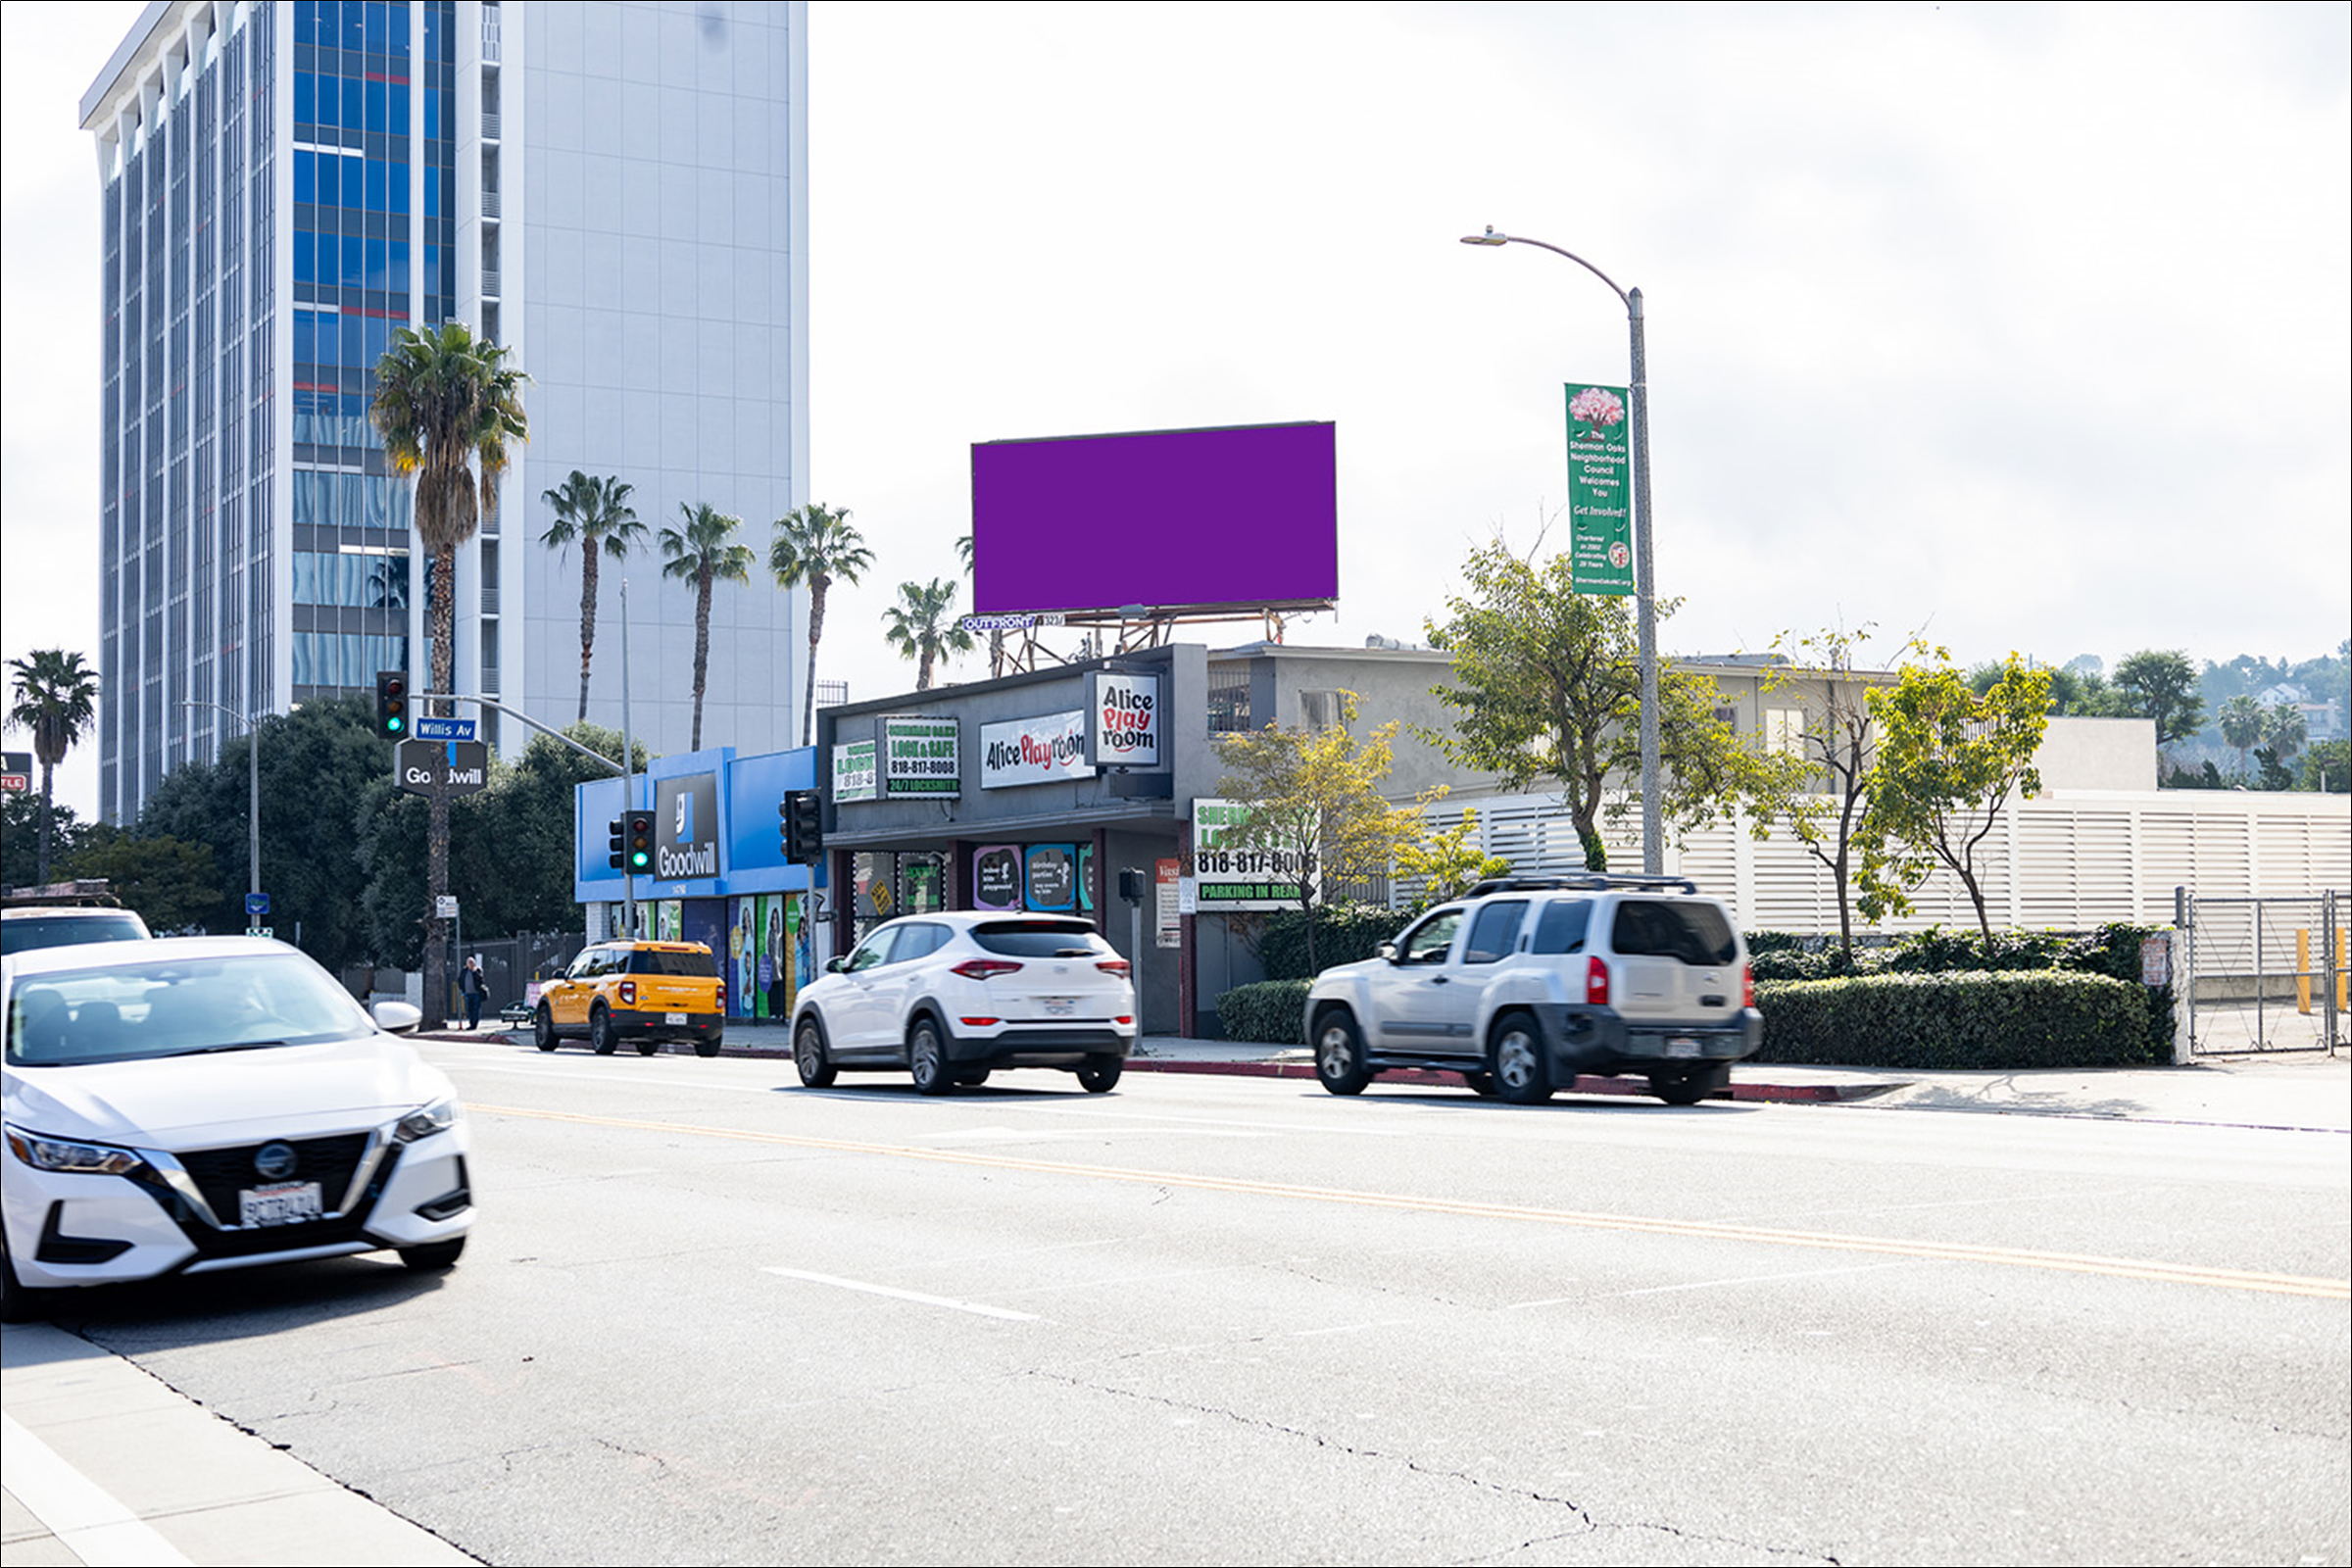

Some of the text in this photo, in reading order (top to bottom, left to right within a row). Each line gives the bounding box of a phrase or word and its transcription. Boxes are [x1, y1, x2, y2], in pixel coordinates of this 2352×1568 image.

[1591, 430, 1605, 440] The
[1570, 440, 1626, 453] Sherman Oaks
[1570, 452, 1626, 465] Neighborhood
[1584, 465, 1614, 474] Council
[1579, 475, 1619, 487] Welcomes
[1592, 488, 1608, 498] You
[1574, 505, 1627, 518] Get Involved!
[966, 616, 1034, 628] OUTFRONT
[1103, 685, 1154, 710] Alice
[1103, 708, 1151, 731] Play
[419, 722, 472, 736] Willis Av
[888, 724, 956, 737] SHERMAN OAKS
[1102, 729, 1154, 749] room
[891, 740, 919, 758] LOCK
[927, 740, 955, 758] SAFE
[891, 760, 956, 774] 818-817-8008
[889, 779, 958, 791] 24/7 LOCKSMITH
[659, 841, 715, 878] Goodwill
[1201, 885, 1254, 899] PARKING
[1255, 885, 1268, 899] IN
